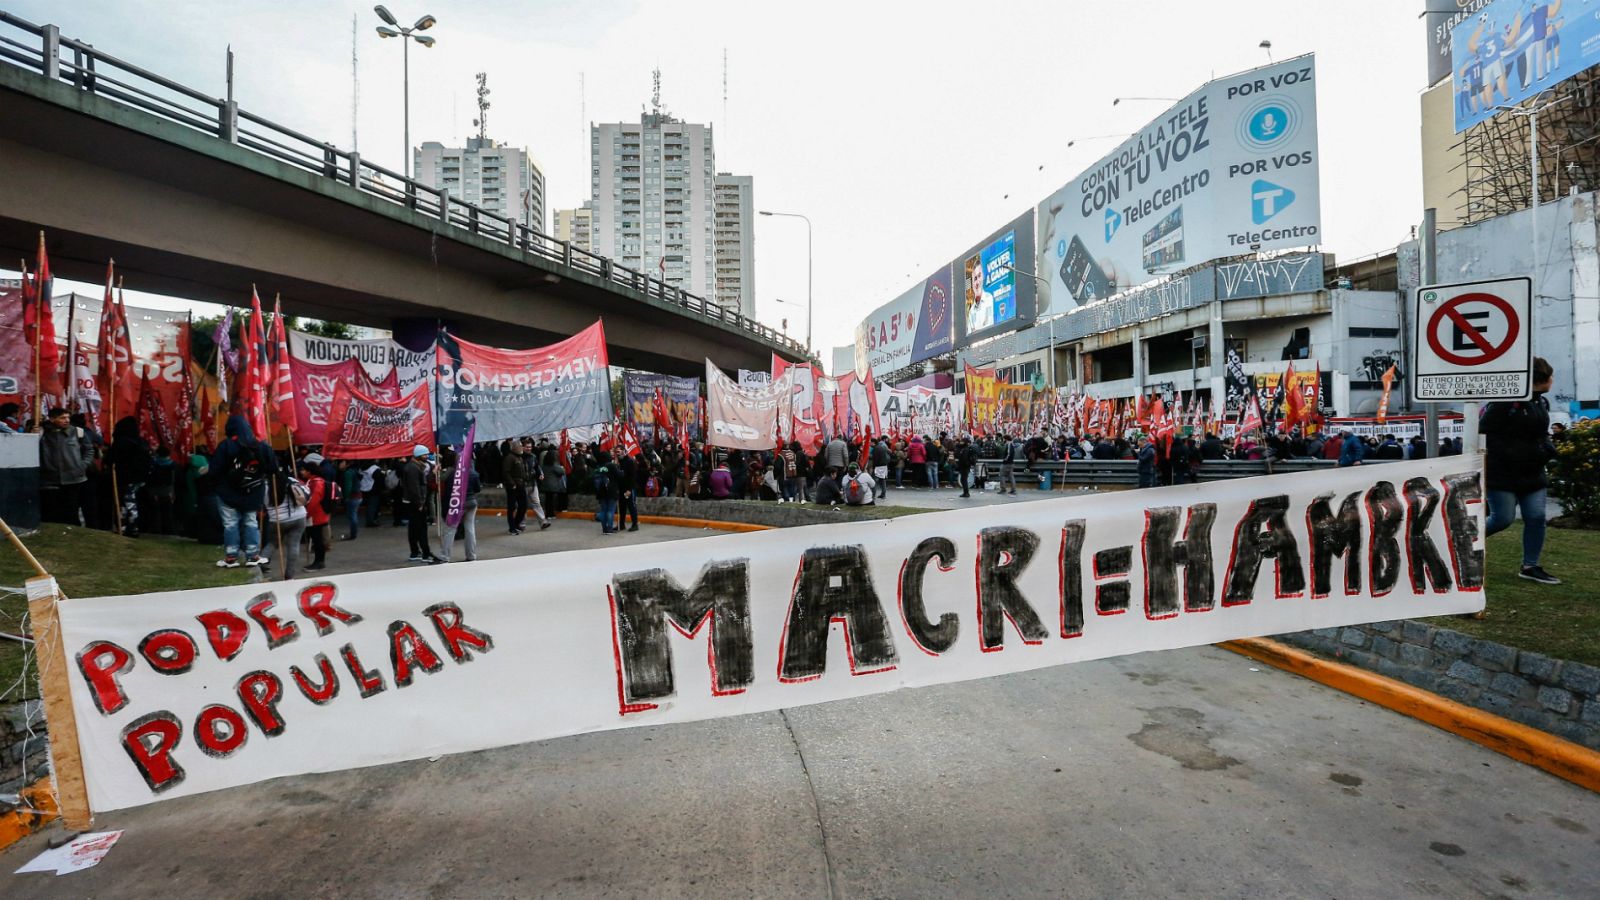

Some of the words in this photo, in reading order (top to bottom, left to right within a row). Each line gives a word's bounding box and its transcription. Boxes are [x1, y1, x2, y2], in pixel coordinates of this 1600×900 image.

[1227, 80, 1266, 99] POR
[1270, 67, 1312, 88] VOZ
[1081, 133, 1146, 194] CONTROLÁ
[1148, 126, 1165, 150] LA
[1167, 95, 1208, 136] TELE
[1081, 177, 1121, 218] CON
[1123, 154, 1151, 191] TU
[1156, 117, 1210, 173] VOZ
[1229, 160, 1268, 178] POR
[1272, 151, 1313, 170] VOS
[1123, 168, 1210, 226] TeleCentro
[1227, 225, 1318, 246] TeleCentro
[1453, 311, 1490, 350] E
[1501, 387, 1520, 395] 519
[76, 581, 364, 716] PODER
[119, 601, 495, 794] POPULAR
